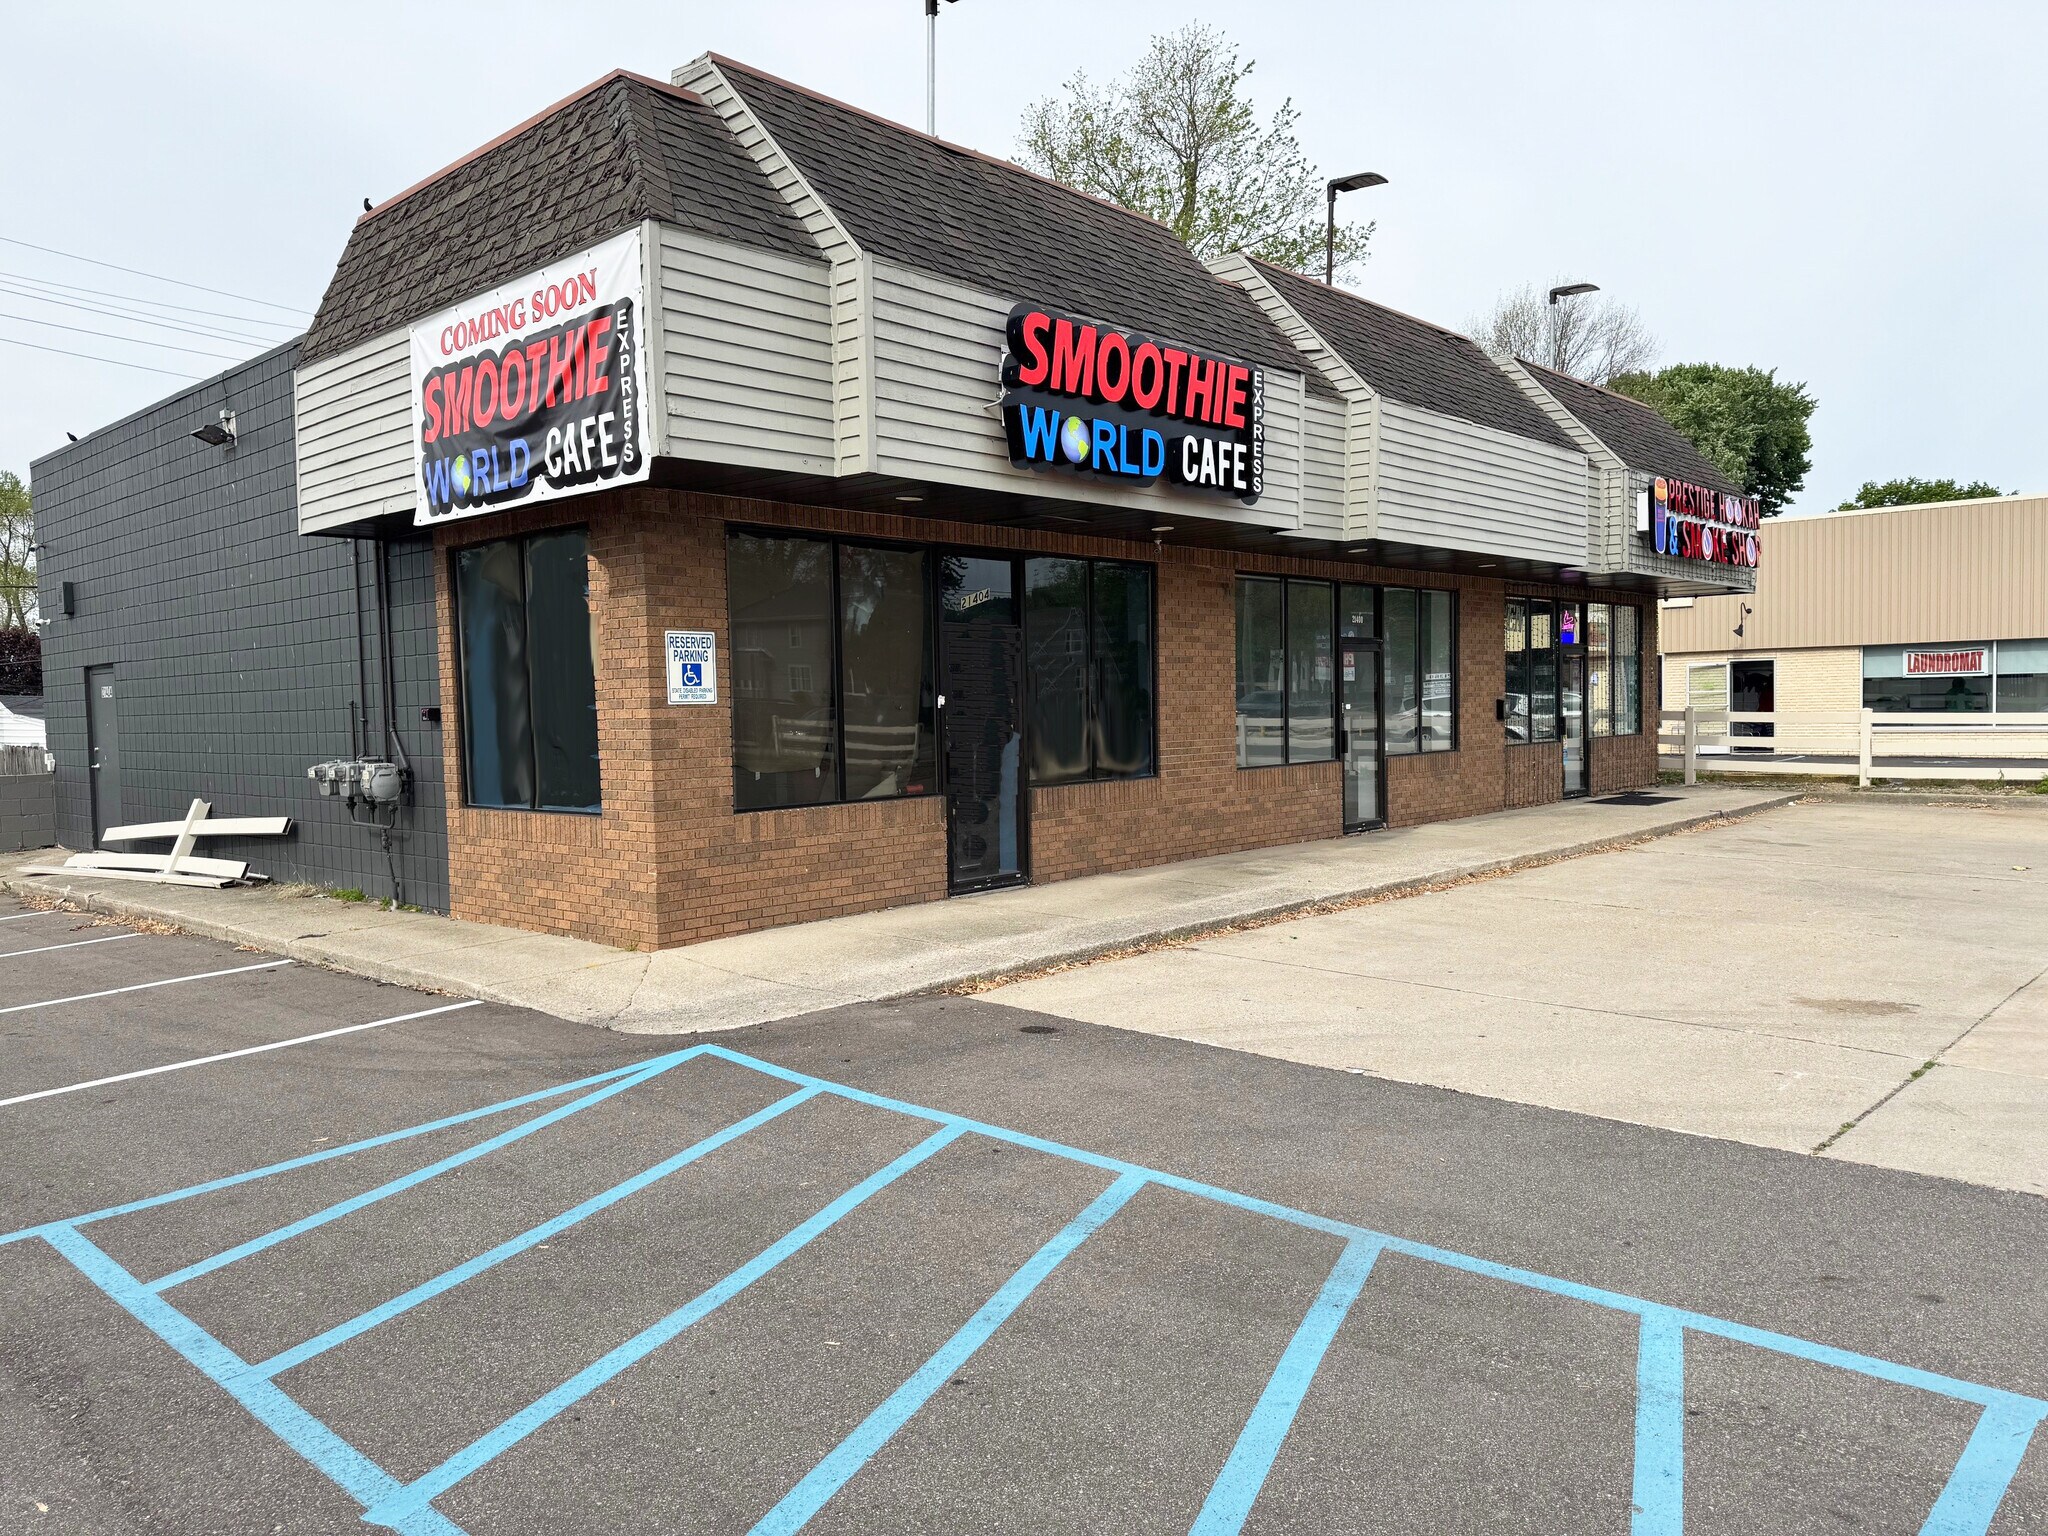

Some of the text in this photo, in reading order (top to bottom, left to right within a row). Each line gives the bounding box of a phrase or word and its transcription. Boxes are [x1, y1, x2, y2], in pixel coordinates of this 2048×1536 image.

[440, 267, 598, 356] COMING SOON
[424, 315, 612, 444] SMOOTHIE
[616, 308, 634, 463] EXPRESS
[1019, 311, 1249, 429] SMOOTHIE
[425, 411, 618, 506] WORLD CAFE
[1019, 403, 1248, 490] WORLD CAFE
[1252, 370, 1264, 493] EXPRESS
[1667, 478, 1760, 530] PRESTIGE HOOKAH
[1669, 516, 1762, 568] & SMOKE SHOP
[669, 636, 712, 649] RESERVED
[961, 589, 990, 609] 21404
[673, 650, 709, 662] PARKING
[1907, 651, 1984, 673] LAUNDROMAT
